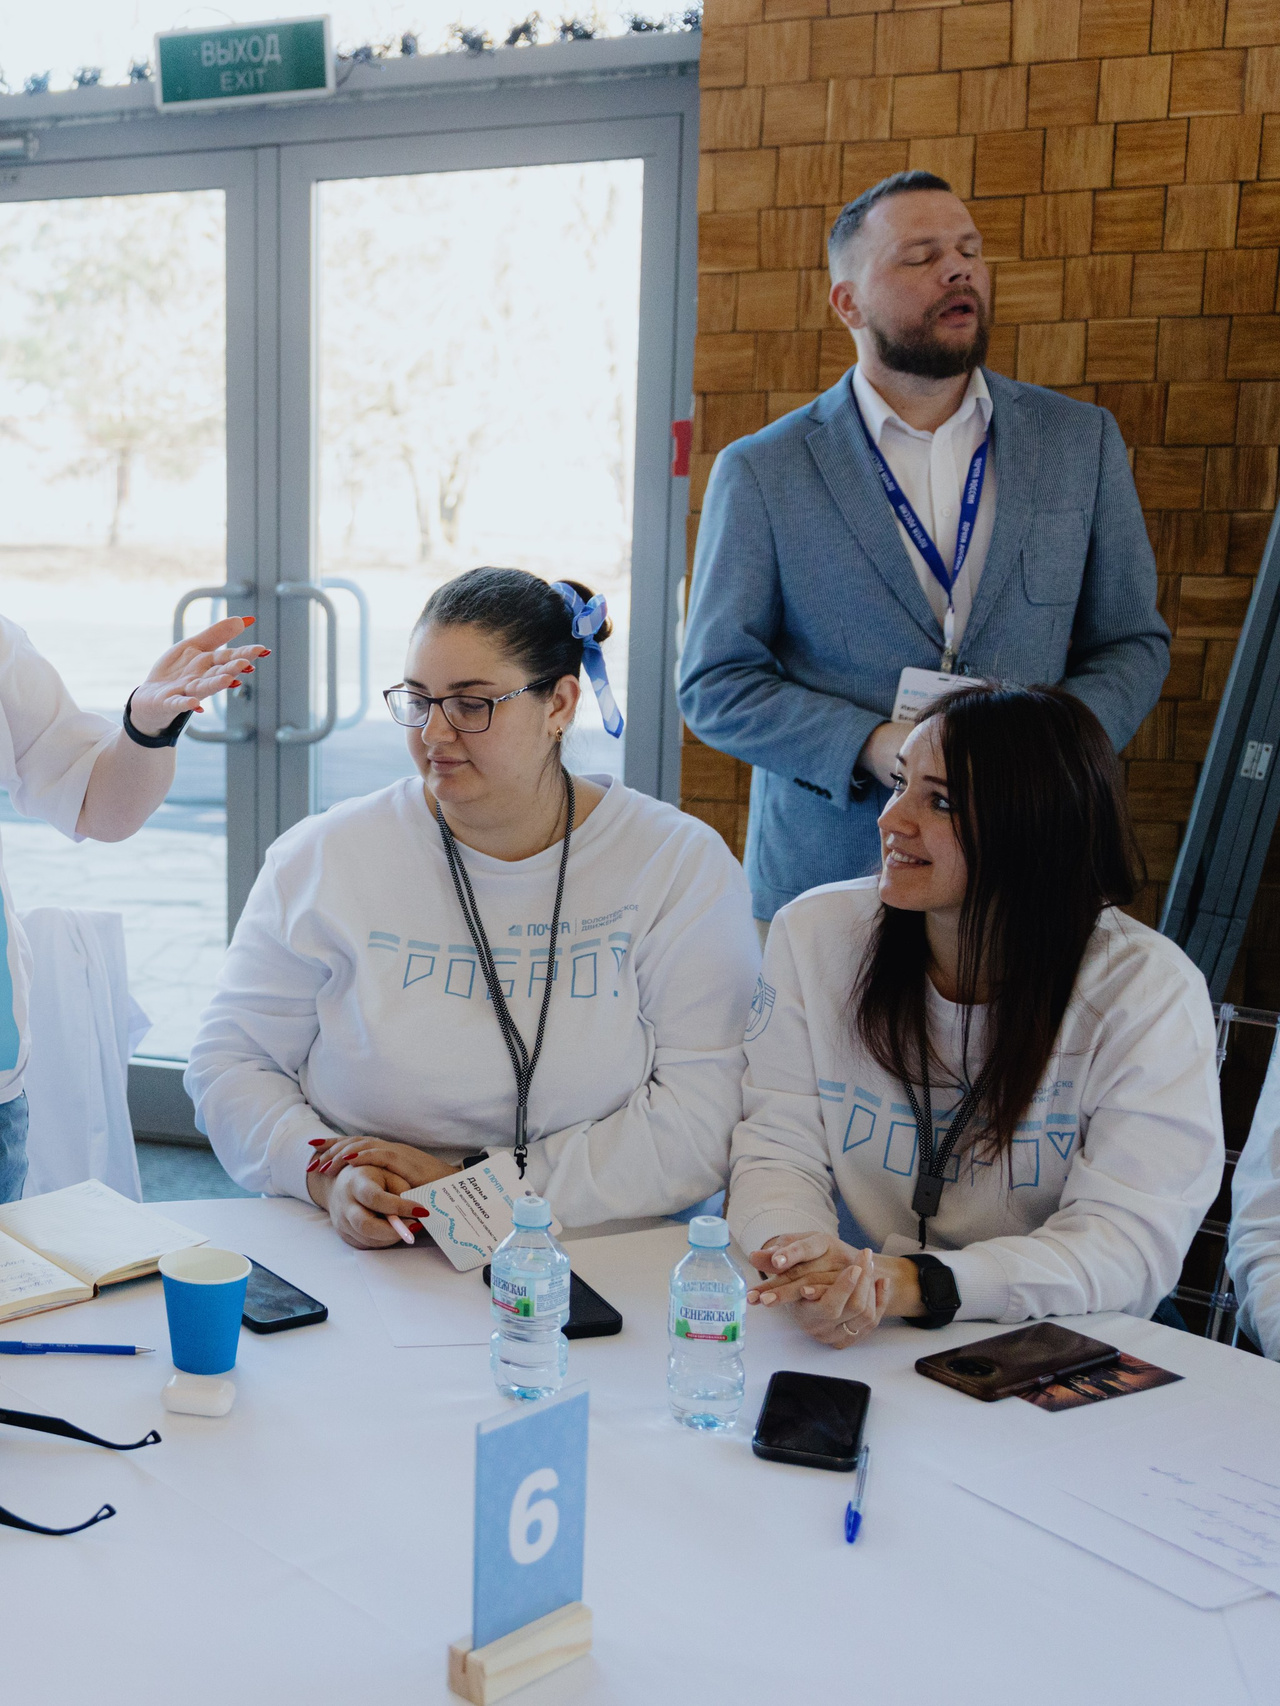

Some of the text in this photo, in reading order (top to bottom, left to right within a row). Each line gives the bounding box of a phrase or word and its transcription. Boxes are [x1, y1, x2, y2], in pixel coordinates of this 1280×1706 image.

[201, 34, 282, 67] ВЫХОД
[221, 69, 267, 92] EXIT
[467, 1176, 489, 1201] Дарья
[488, 1174, 505, 1194] ПОЧТА
[458, 1180, 490, 1219] Кравченко
[459, 1241, 487, 1257] СЕРДЦА
[680, 1306, 735, 1322] СЕНЕЖСКАЯ
[509, 1467, 559, 1564] 6
